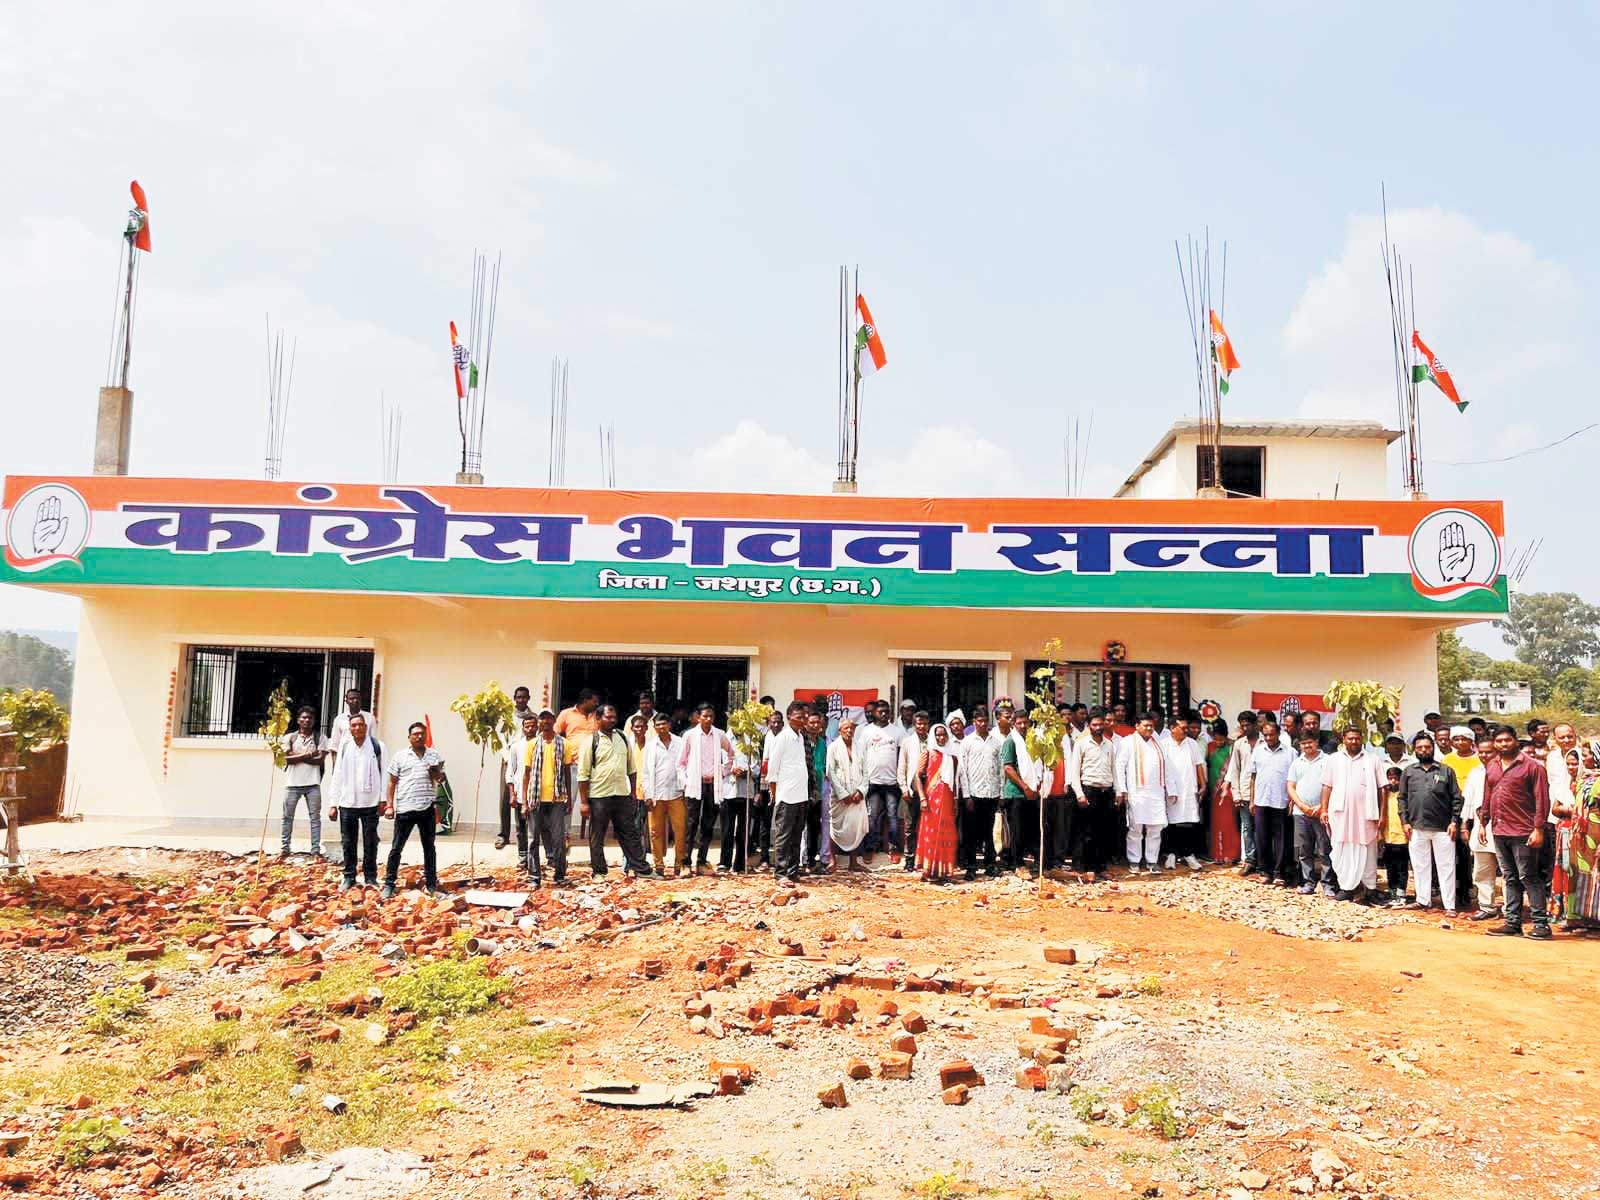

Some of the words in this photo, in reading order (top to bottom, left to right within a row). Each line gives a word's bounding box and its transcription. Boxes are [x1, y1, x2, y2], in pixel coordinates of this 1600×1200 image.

[122, 486, 583, 563] कांग्रेस
[616, 516, 963, 571] भवन
[992, 525, 1374, 575] सन्ना
[598, 569, 669, 591] जिला
[694, 574, 783, 598] जशपुर
[788, 575, 882, 598] (छ.ग.)
